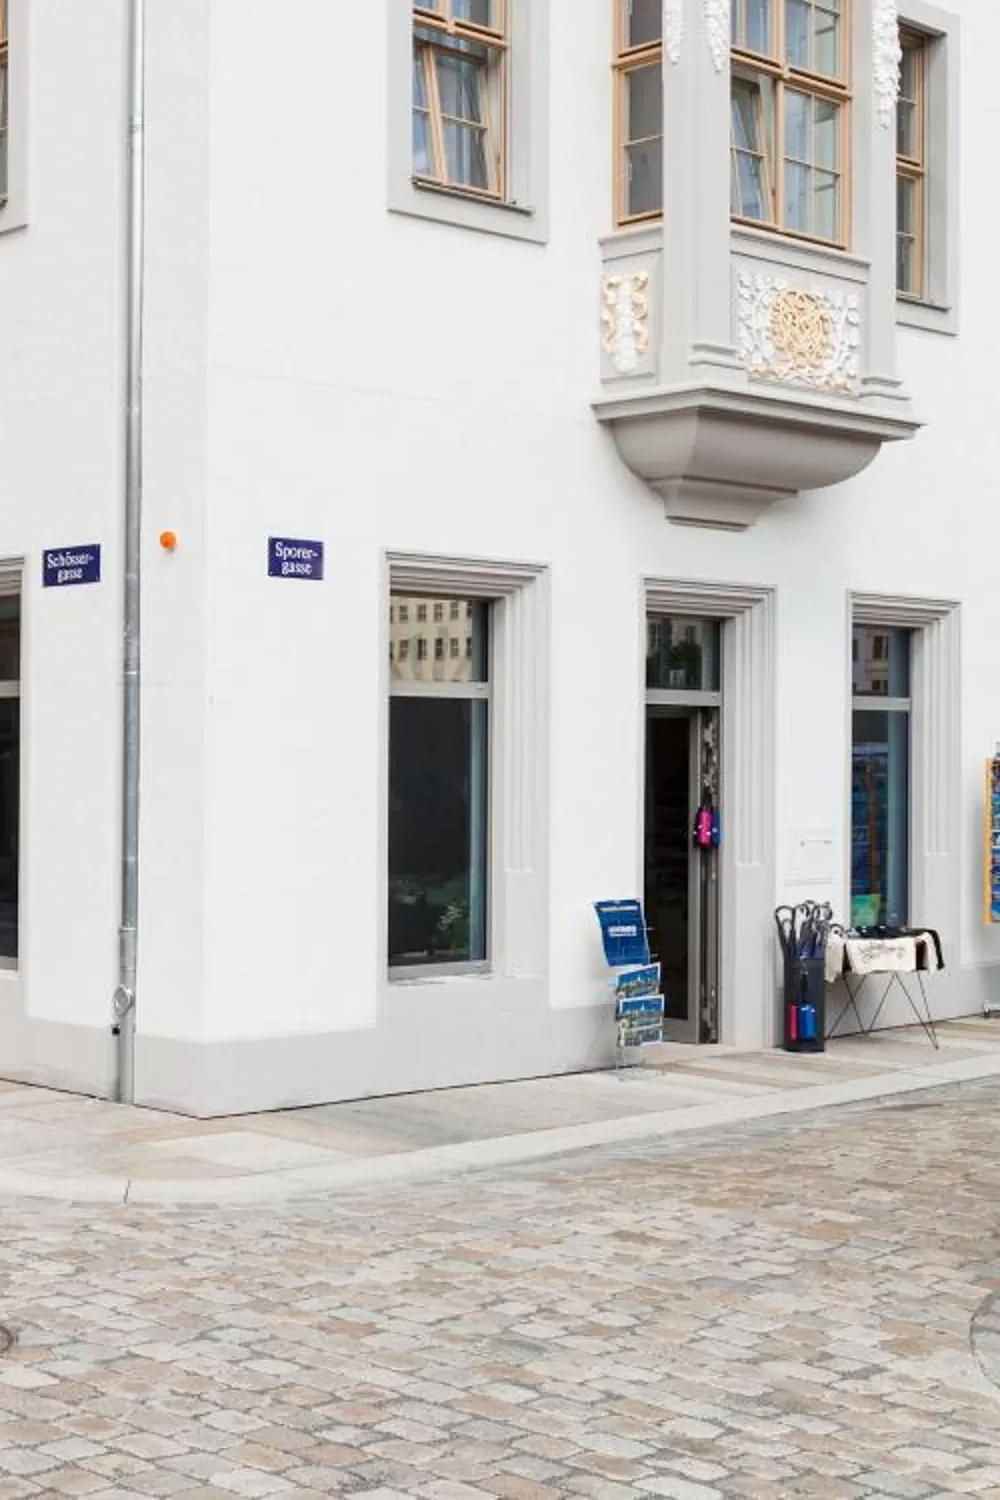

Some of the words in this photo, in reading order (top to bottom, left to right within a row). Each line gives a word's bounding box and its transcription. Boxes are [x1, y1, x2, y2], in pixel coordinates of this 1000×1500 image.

[275, 541, 319, 560] Sporer-
[57, 568, 82, 583] gasse
[281, 561, 312, 575] gasse
